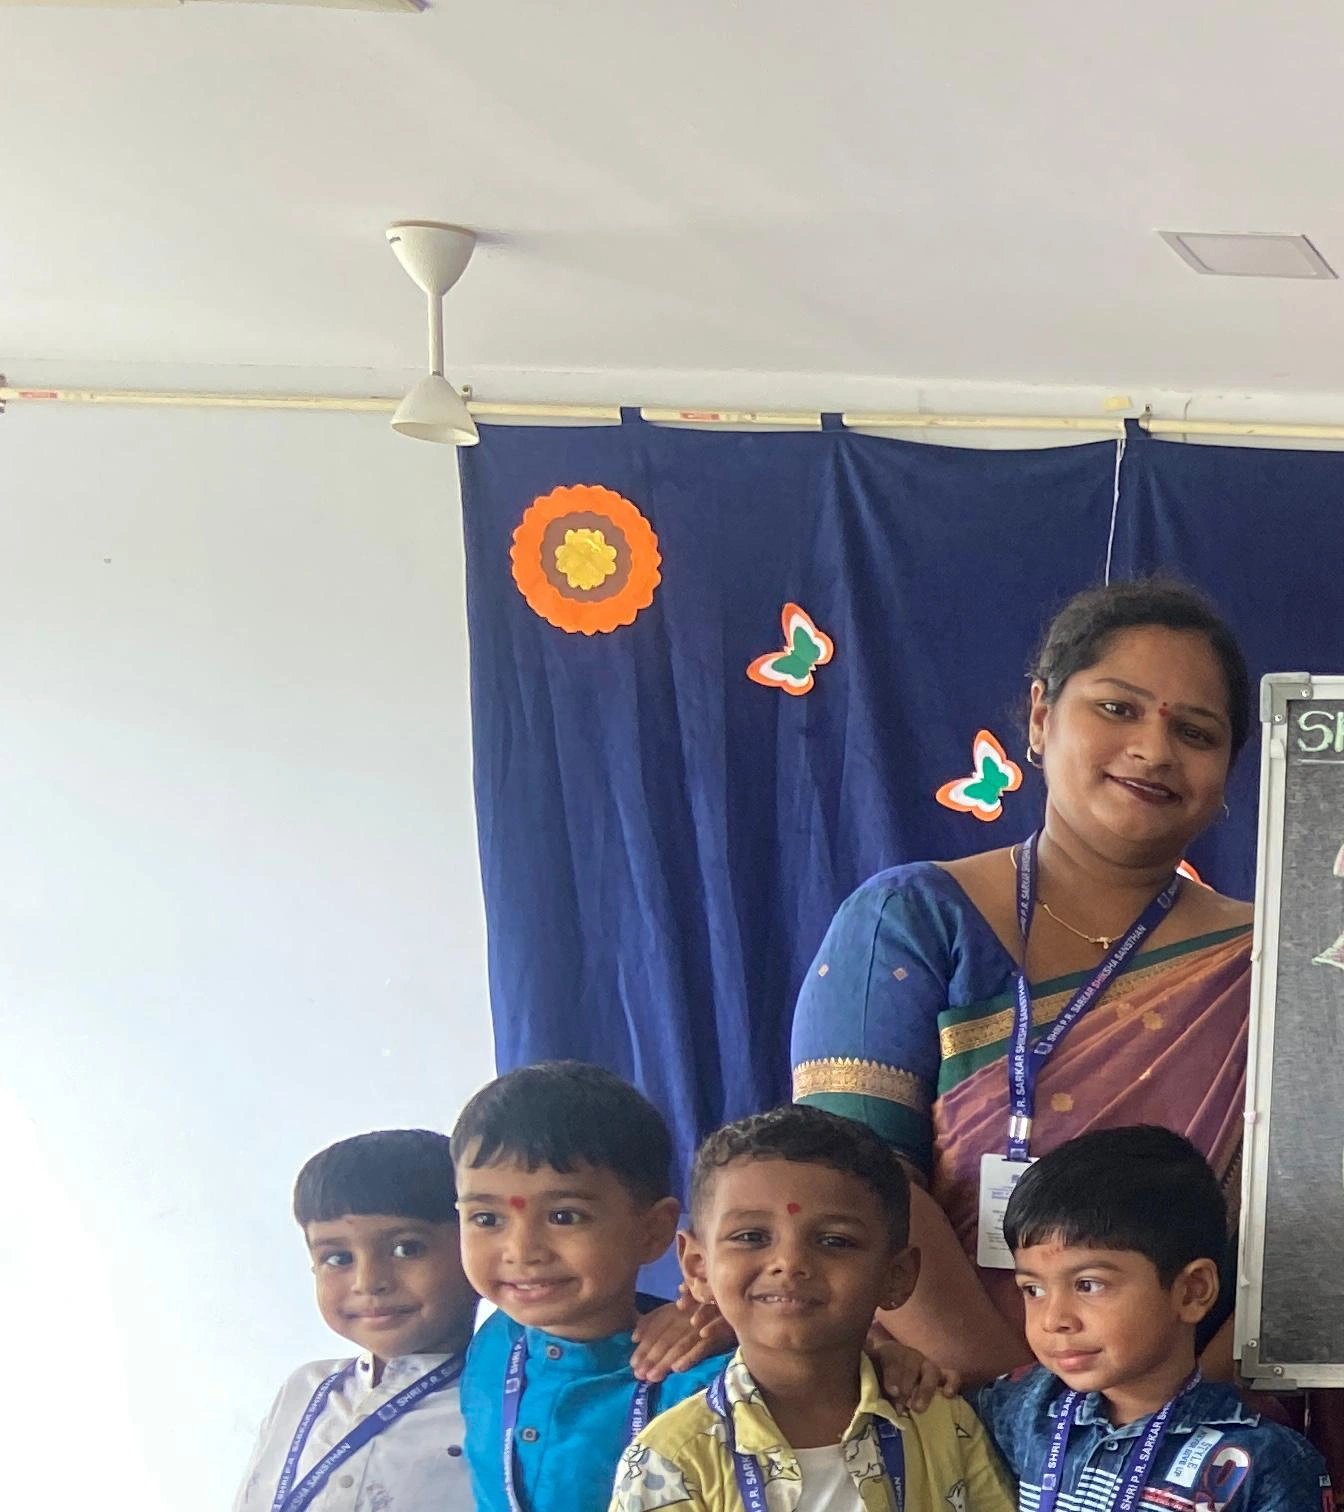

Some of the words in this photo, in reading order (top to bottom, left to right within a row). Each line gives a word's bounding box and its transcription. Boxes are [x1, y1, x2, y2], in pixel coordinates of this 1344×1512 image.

[1069, 985, 1095, 1014] SARKAR
[1090, 958, 1120, 990] SHIKSHA
[1112, 923, 1148, 962] SANSTHAN
[1014, 1054, 1026, 1096] SARKAR
[1047, 1441, 1062, 1469] SHRI
[1120, 1484, 1138, 1511] SHRI
[1139, 1420, 1162, 1462] SARKAR
